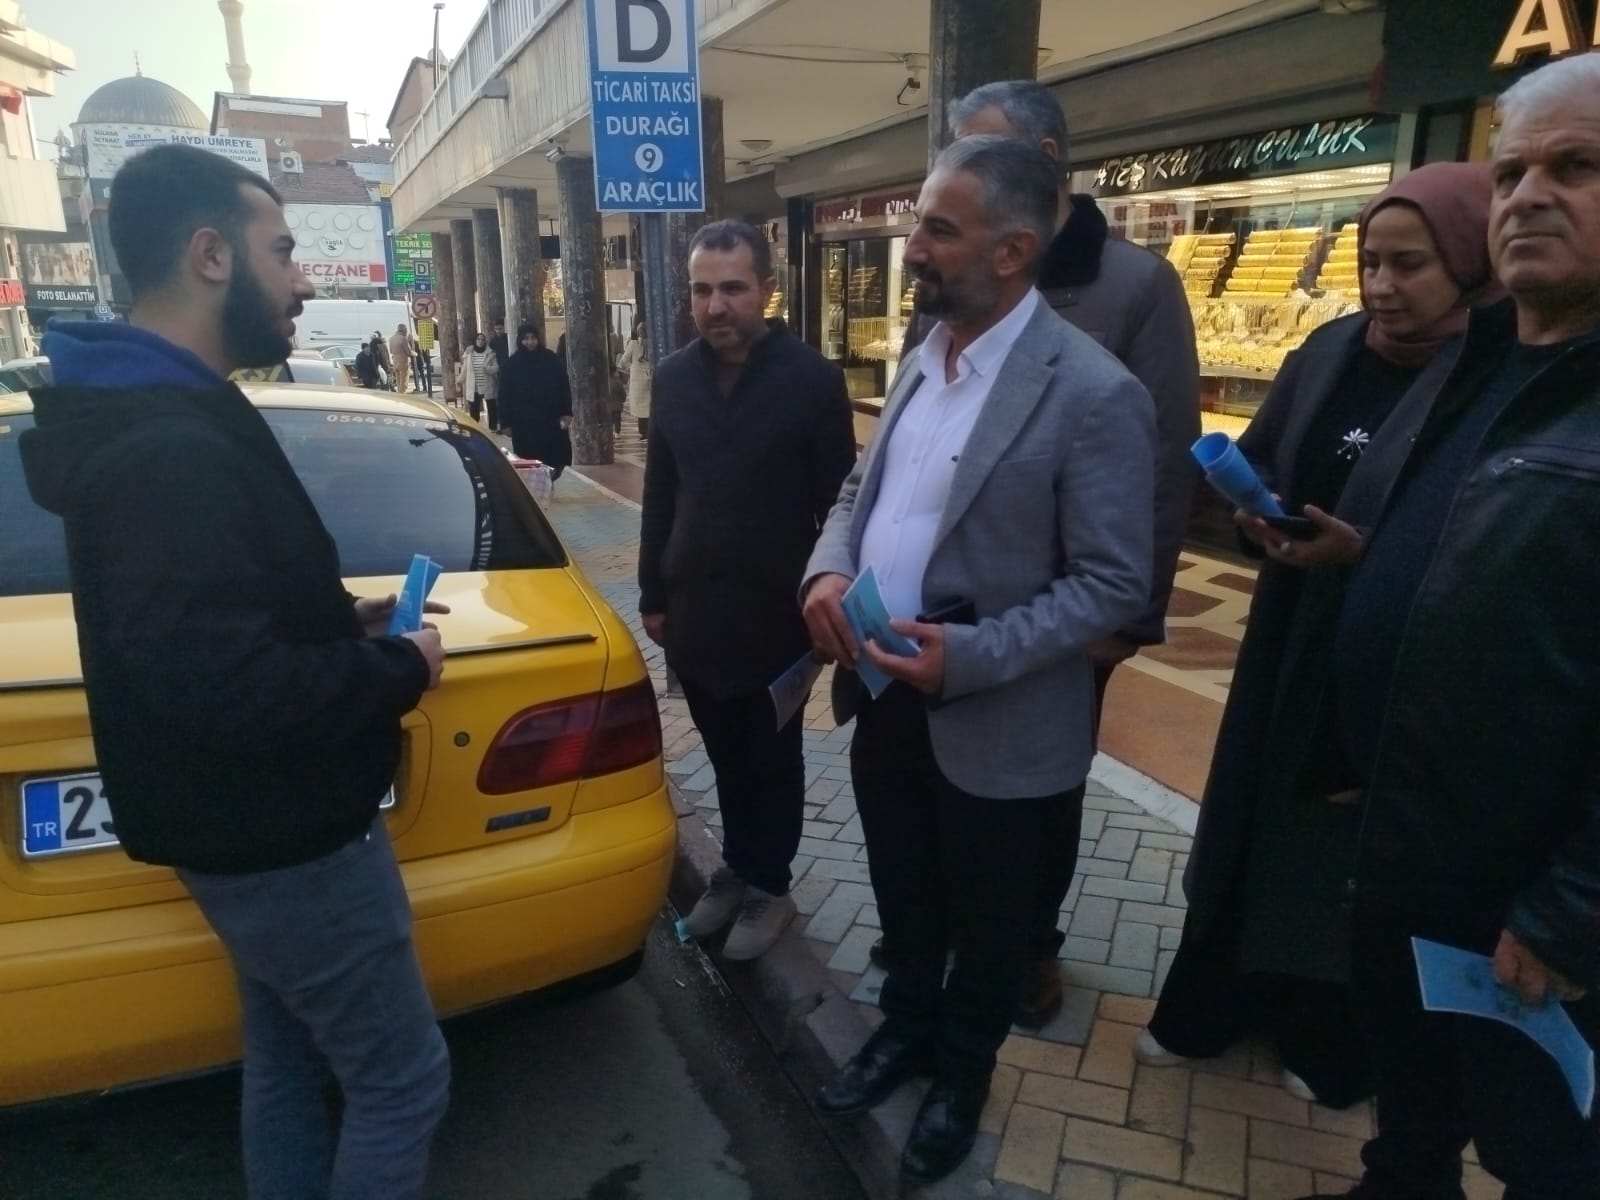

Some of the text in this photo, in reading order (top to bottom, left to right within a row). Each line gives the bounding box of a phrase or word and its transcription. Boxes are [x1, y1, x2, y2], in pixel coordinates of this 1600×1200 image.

[615, 0, 672, 63] D
[1494, 0, 1600, 65] A
[594, 75, 696, 103] TİCARİ TAKSİ
[606, 111, 690, 136] DURAĞI
[207, 137, 253, 148] UMREYE
[642, 147, 657, 170] 9
[603, 181, 699, 206] ARAÇLIK
[301, 263, 369, 277] ECZANE
[416, 263, 427, 275] D
[37, 289, 96, 301] FOTO SELAHATTİN
[32, 821, 57, 839] TR
